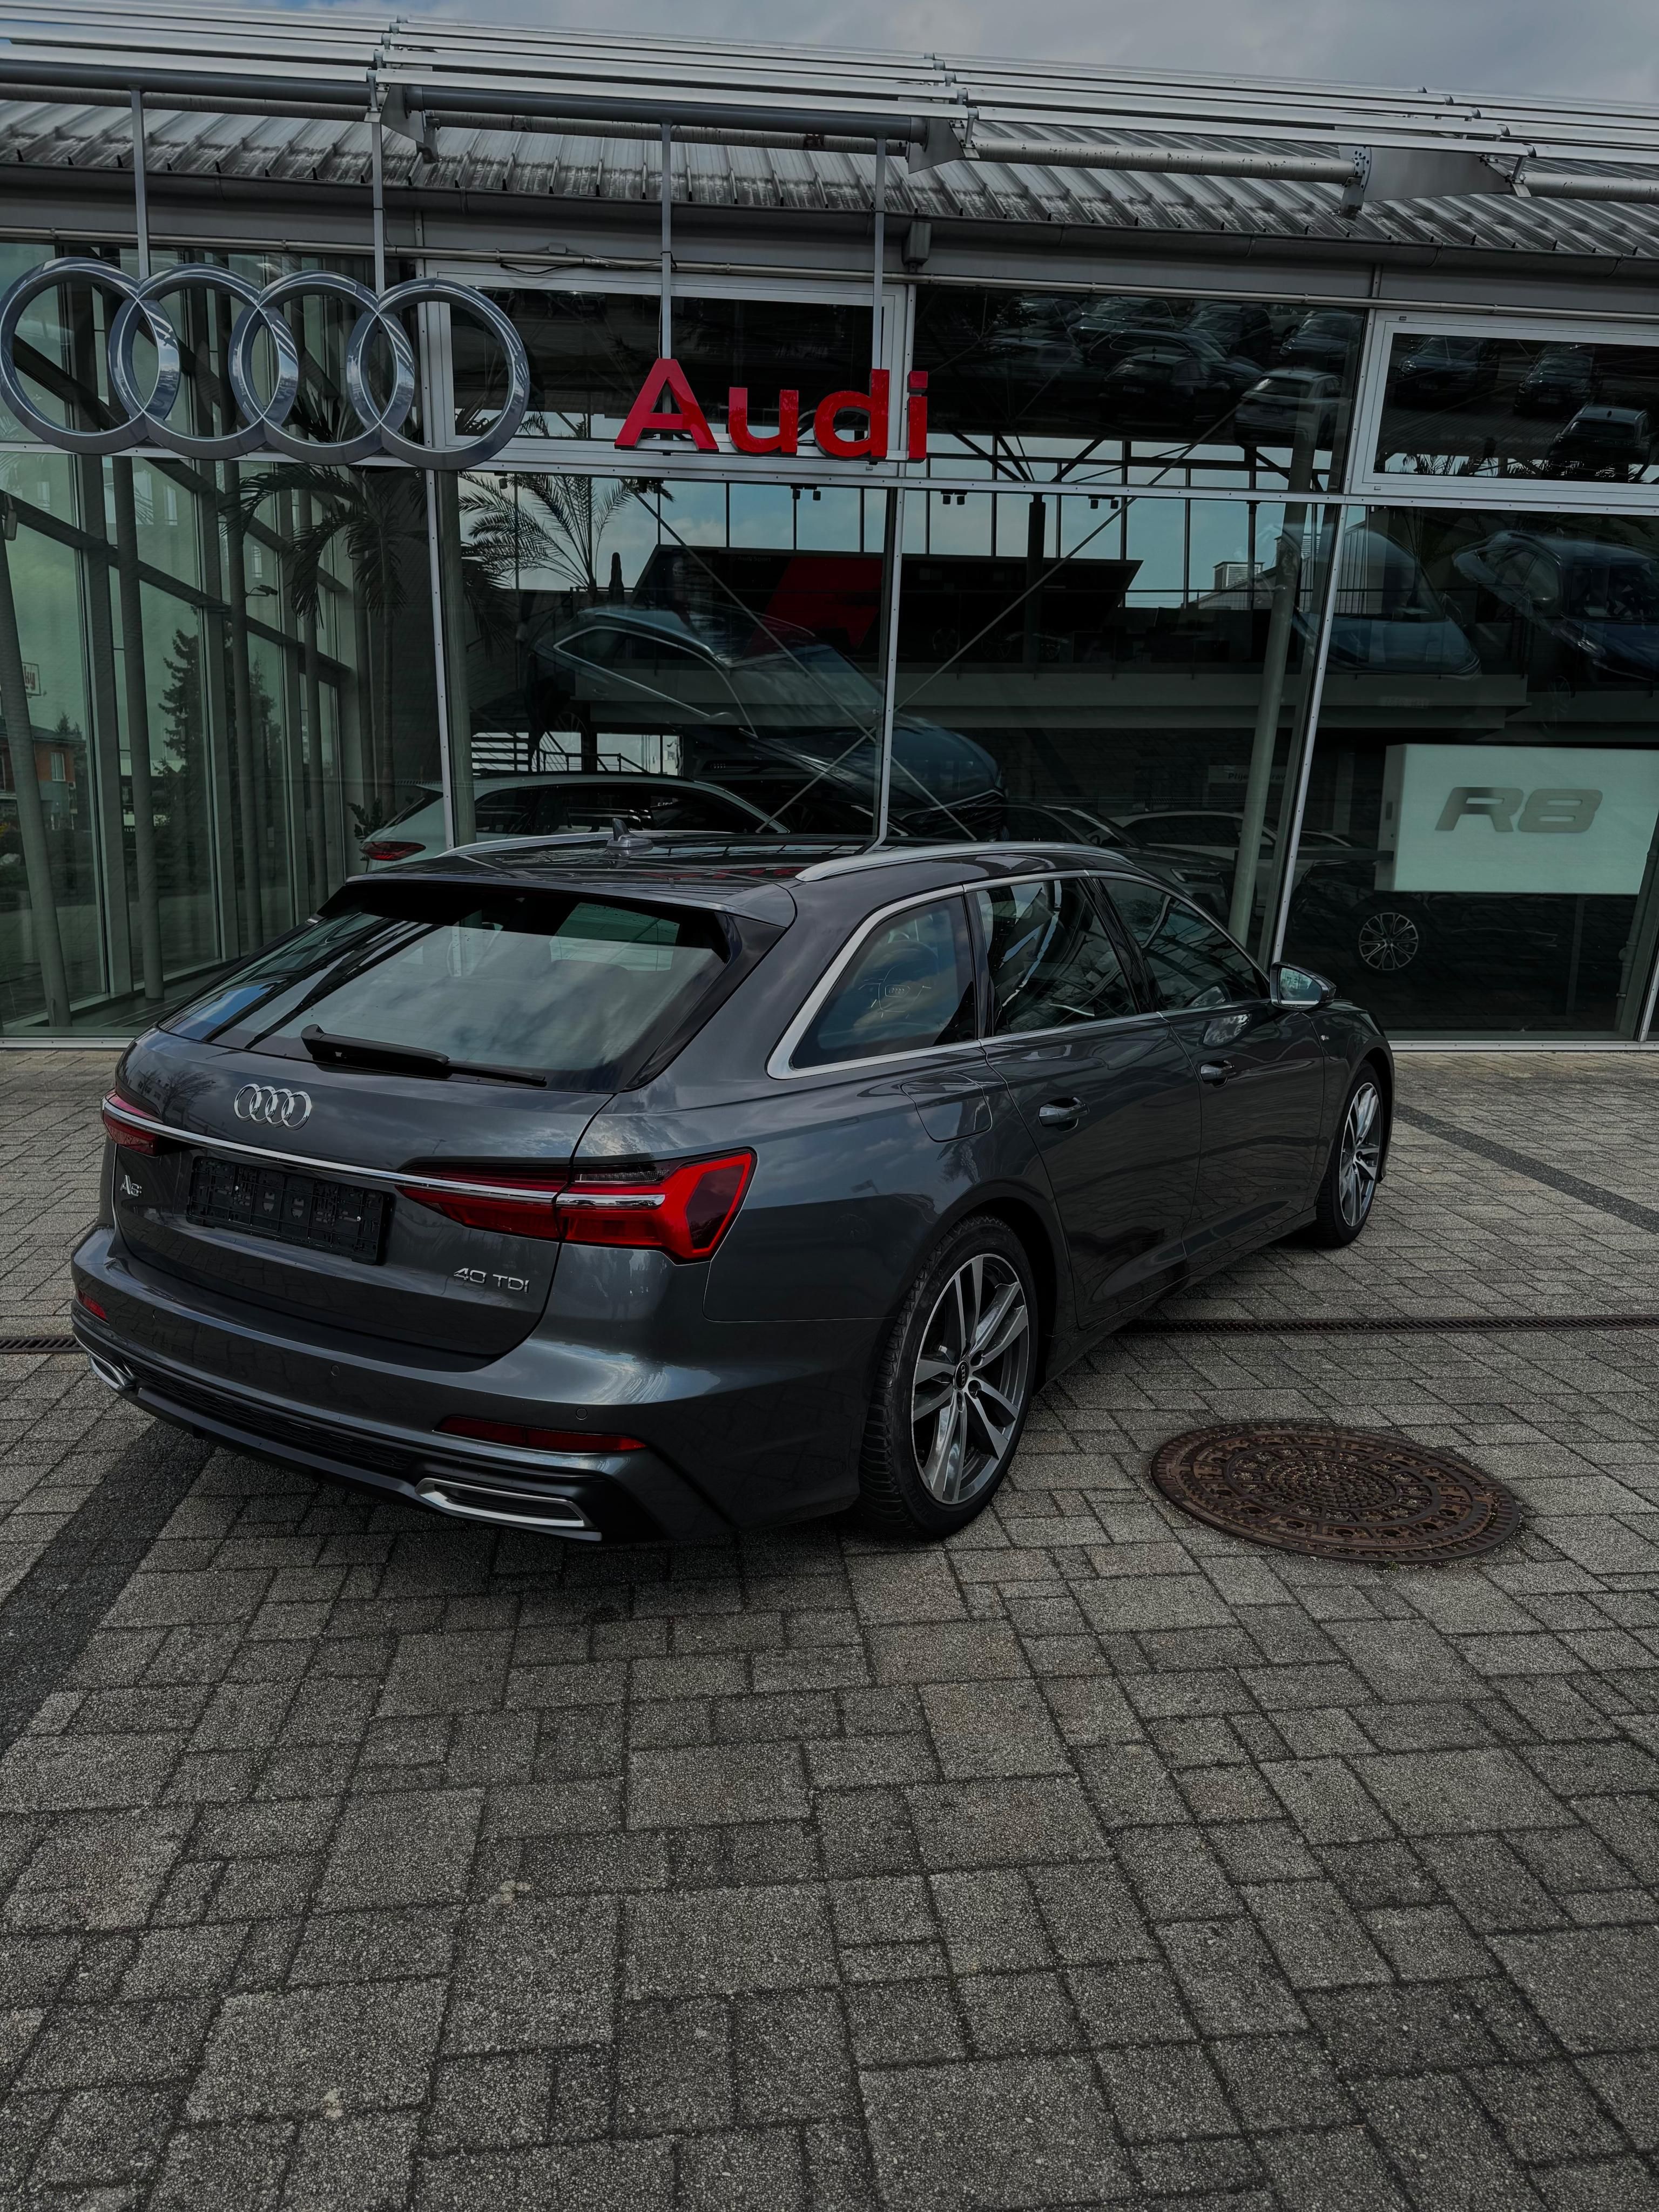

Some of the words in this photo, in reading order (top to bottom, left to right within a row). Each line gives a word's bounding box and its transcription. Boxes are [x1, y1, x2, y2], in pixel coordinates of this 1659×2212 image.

[615, 358, 928, 463] Audi
[1434, 787, 1603, 833] R8
[120, 1175, 142, 1197] A6
[453, 1267, 487, 1284] 40
[493, 1274, 530, 1294] TDI
